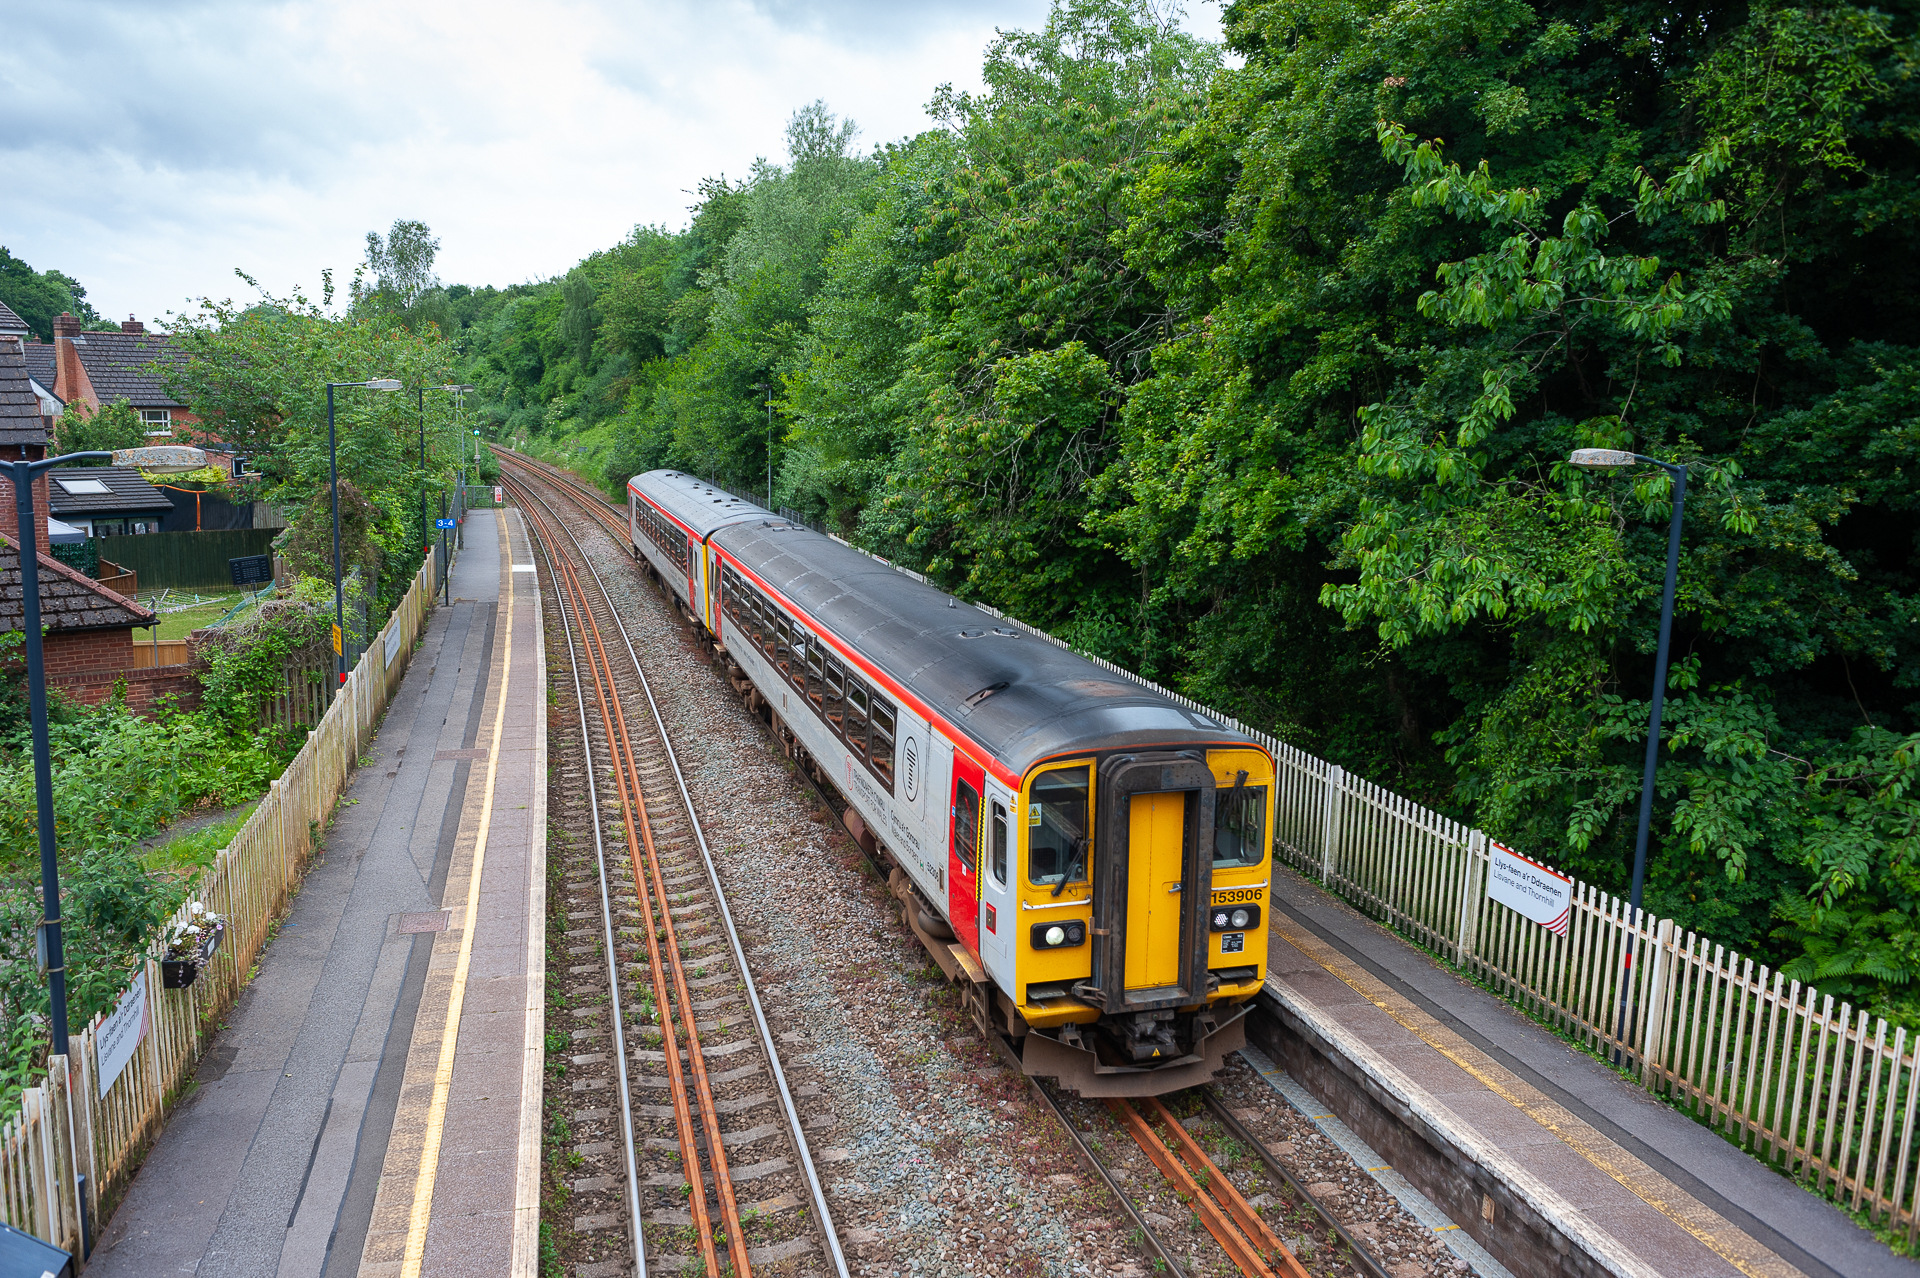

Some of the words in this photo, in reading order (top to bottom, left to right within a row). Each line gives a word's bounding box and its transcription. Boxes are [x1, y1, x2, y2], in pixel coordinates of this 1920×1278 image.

[1211, 889, 1262, 903] 153906
[1493, 869, 1514, 887] Lisvane
[1515, 882, 1527, 893] and
[1527, 886, 1554, 907] Thornhill
[1494, 857, 1521, 877] Llys-faen
[1522, 872, 1531, 881] a'r
[1531, 875, 1561, 898] Ddraenen
